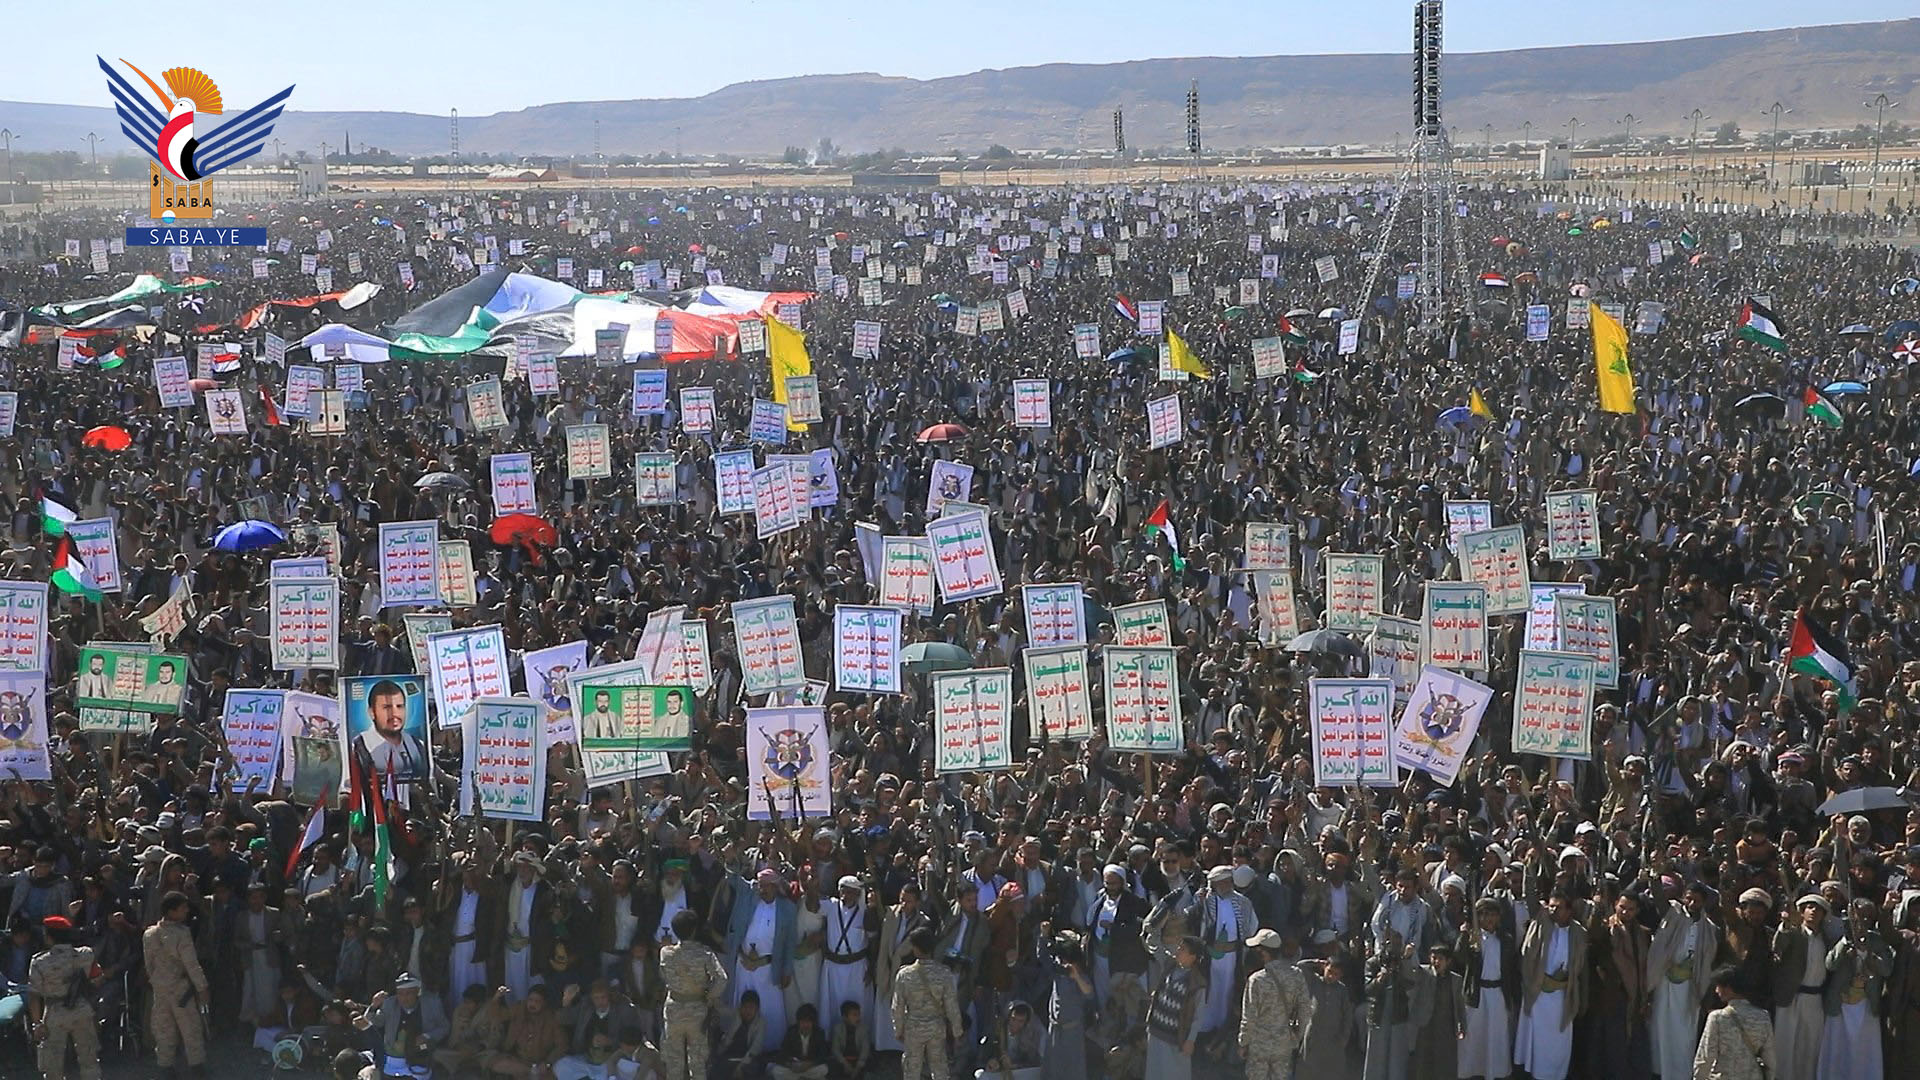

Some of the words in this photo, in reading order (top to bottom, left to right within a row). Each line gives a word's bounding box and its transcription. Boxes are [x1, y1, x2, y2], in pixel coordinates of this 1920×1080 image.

[313, 589, 332, 602] الله
[1564, 662, 1588, 679] الله
[981, 678, 1003, 694] الله
[1361, 690, 1384, 706] الله
[977, 700, 1003, 713] الموت
[513, 712, 534, 728] الله
[978, 716, 1003, 730] الموت
[1357, 713, 1385, 724] الموت
[944, 735, 965, 748] اليهود
[1358, 730, 1385, 742] الموت
[978, 745, 1003, 764] النصر
[1323, 747, 1345, 758] اليهود
[1360, 760, 1386, 777] النصر
